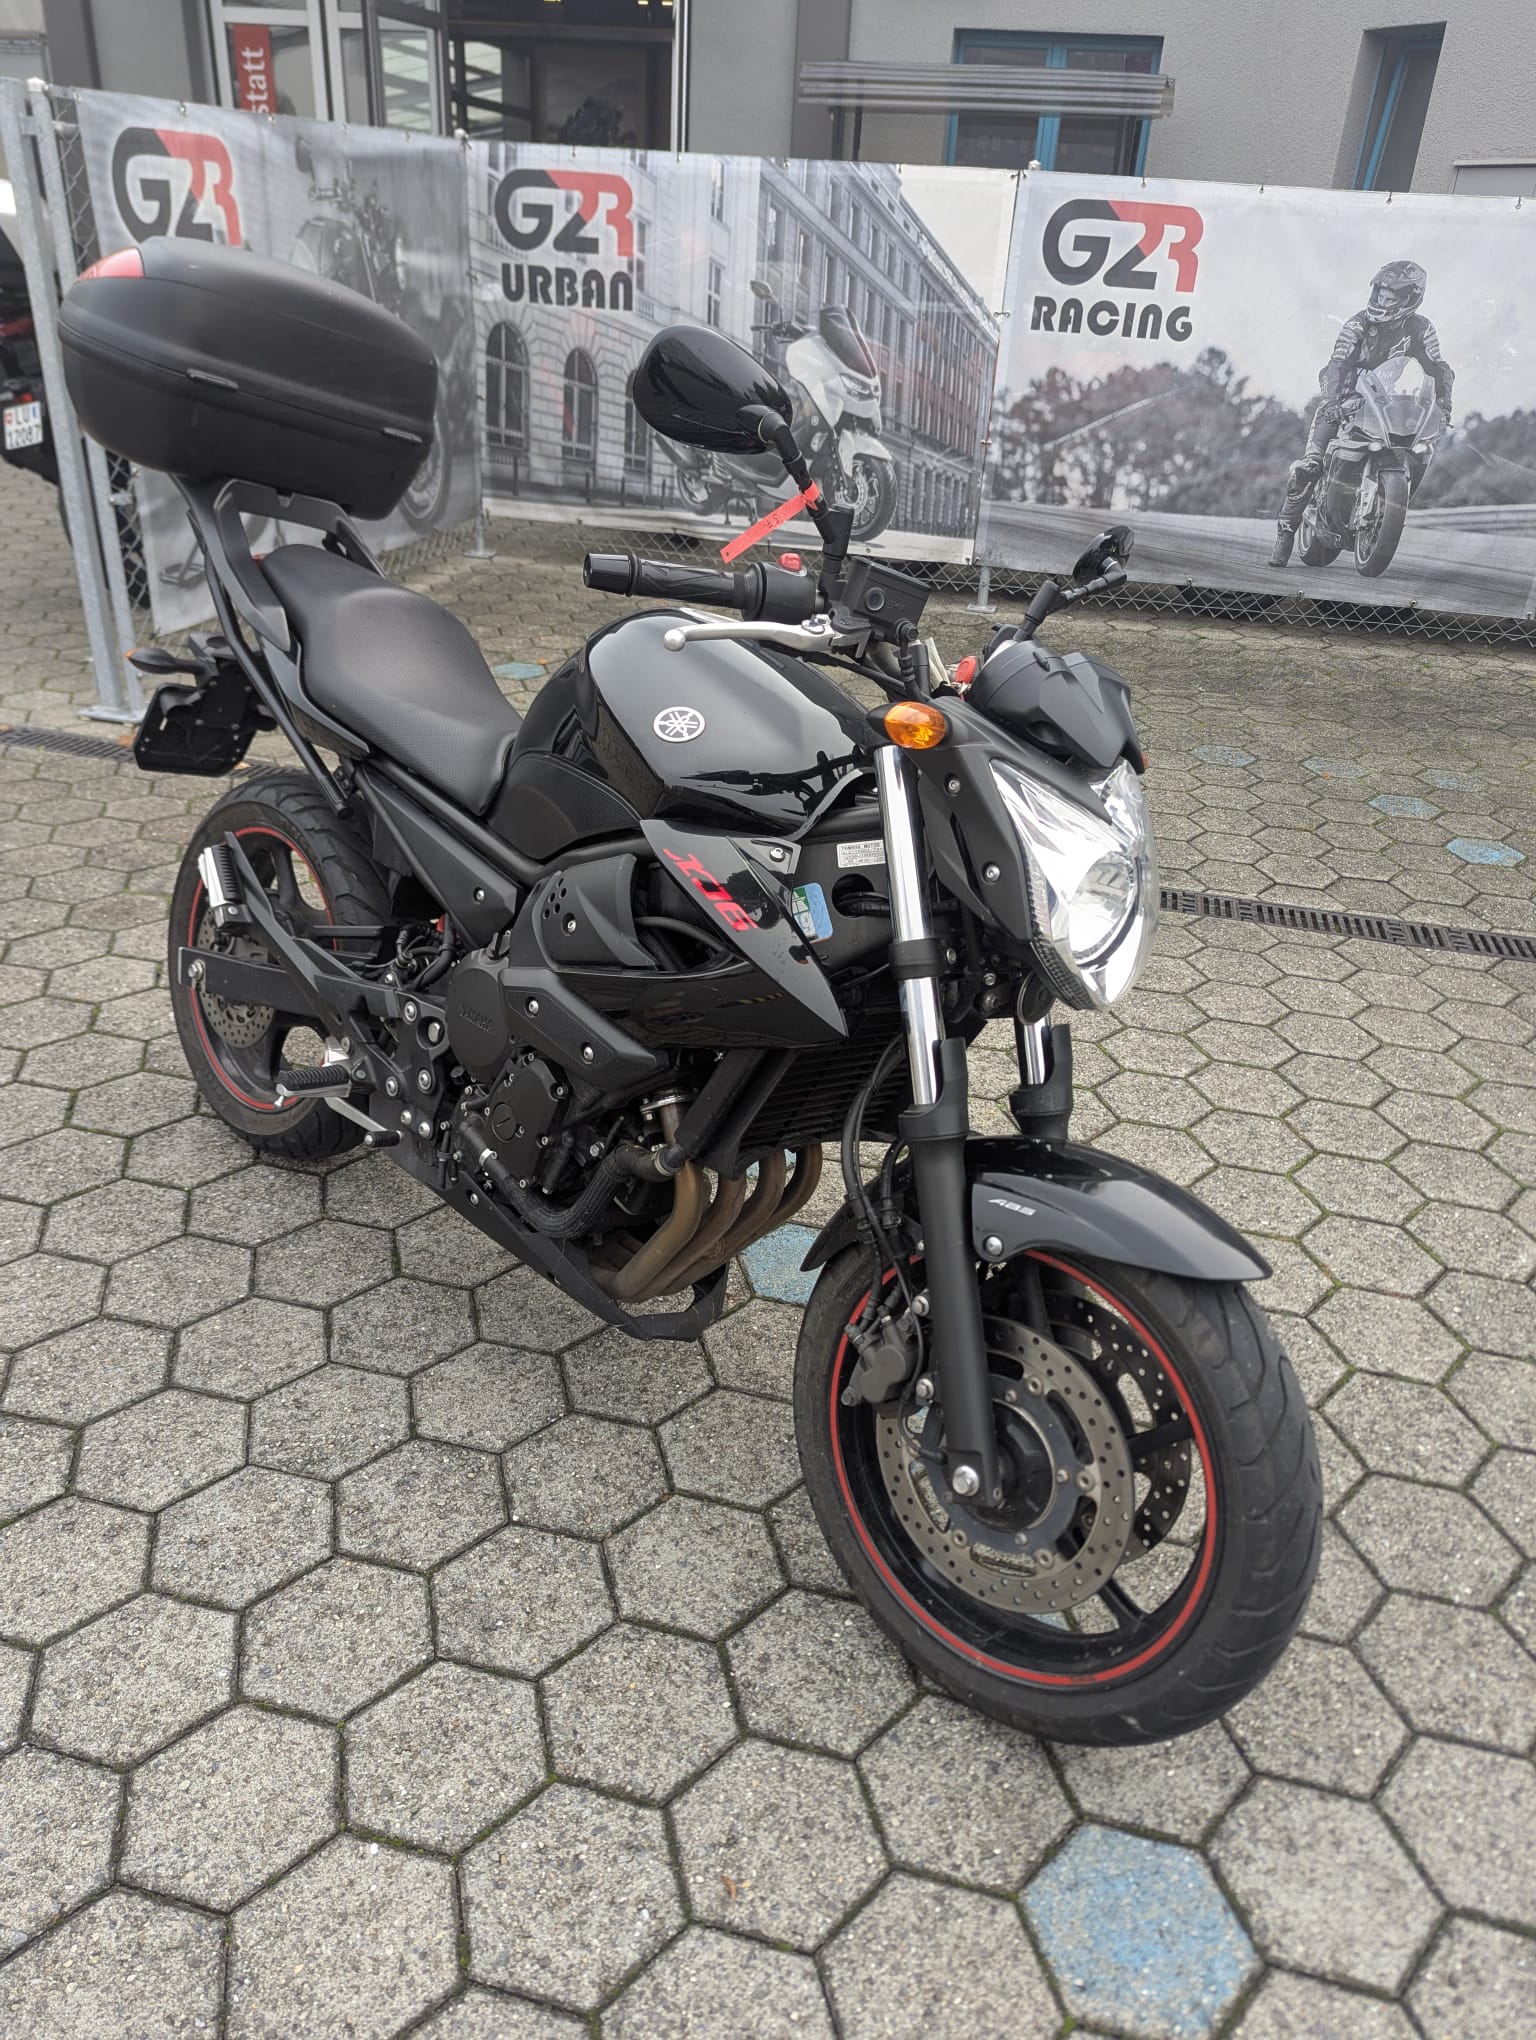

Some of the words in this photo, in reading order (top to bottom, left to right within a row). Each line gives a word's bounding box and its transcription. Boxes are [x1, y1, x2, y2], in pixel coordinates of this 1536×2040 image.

[502, 263, 633, 311] URBAN
[1030, 296, 1193, 342] RACING
[662, 848, 759, 932] XJ6
